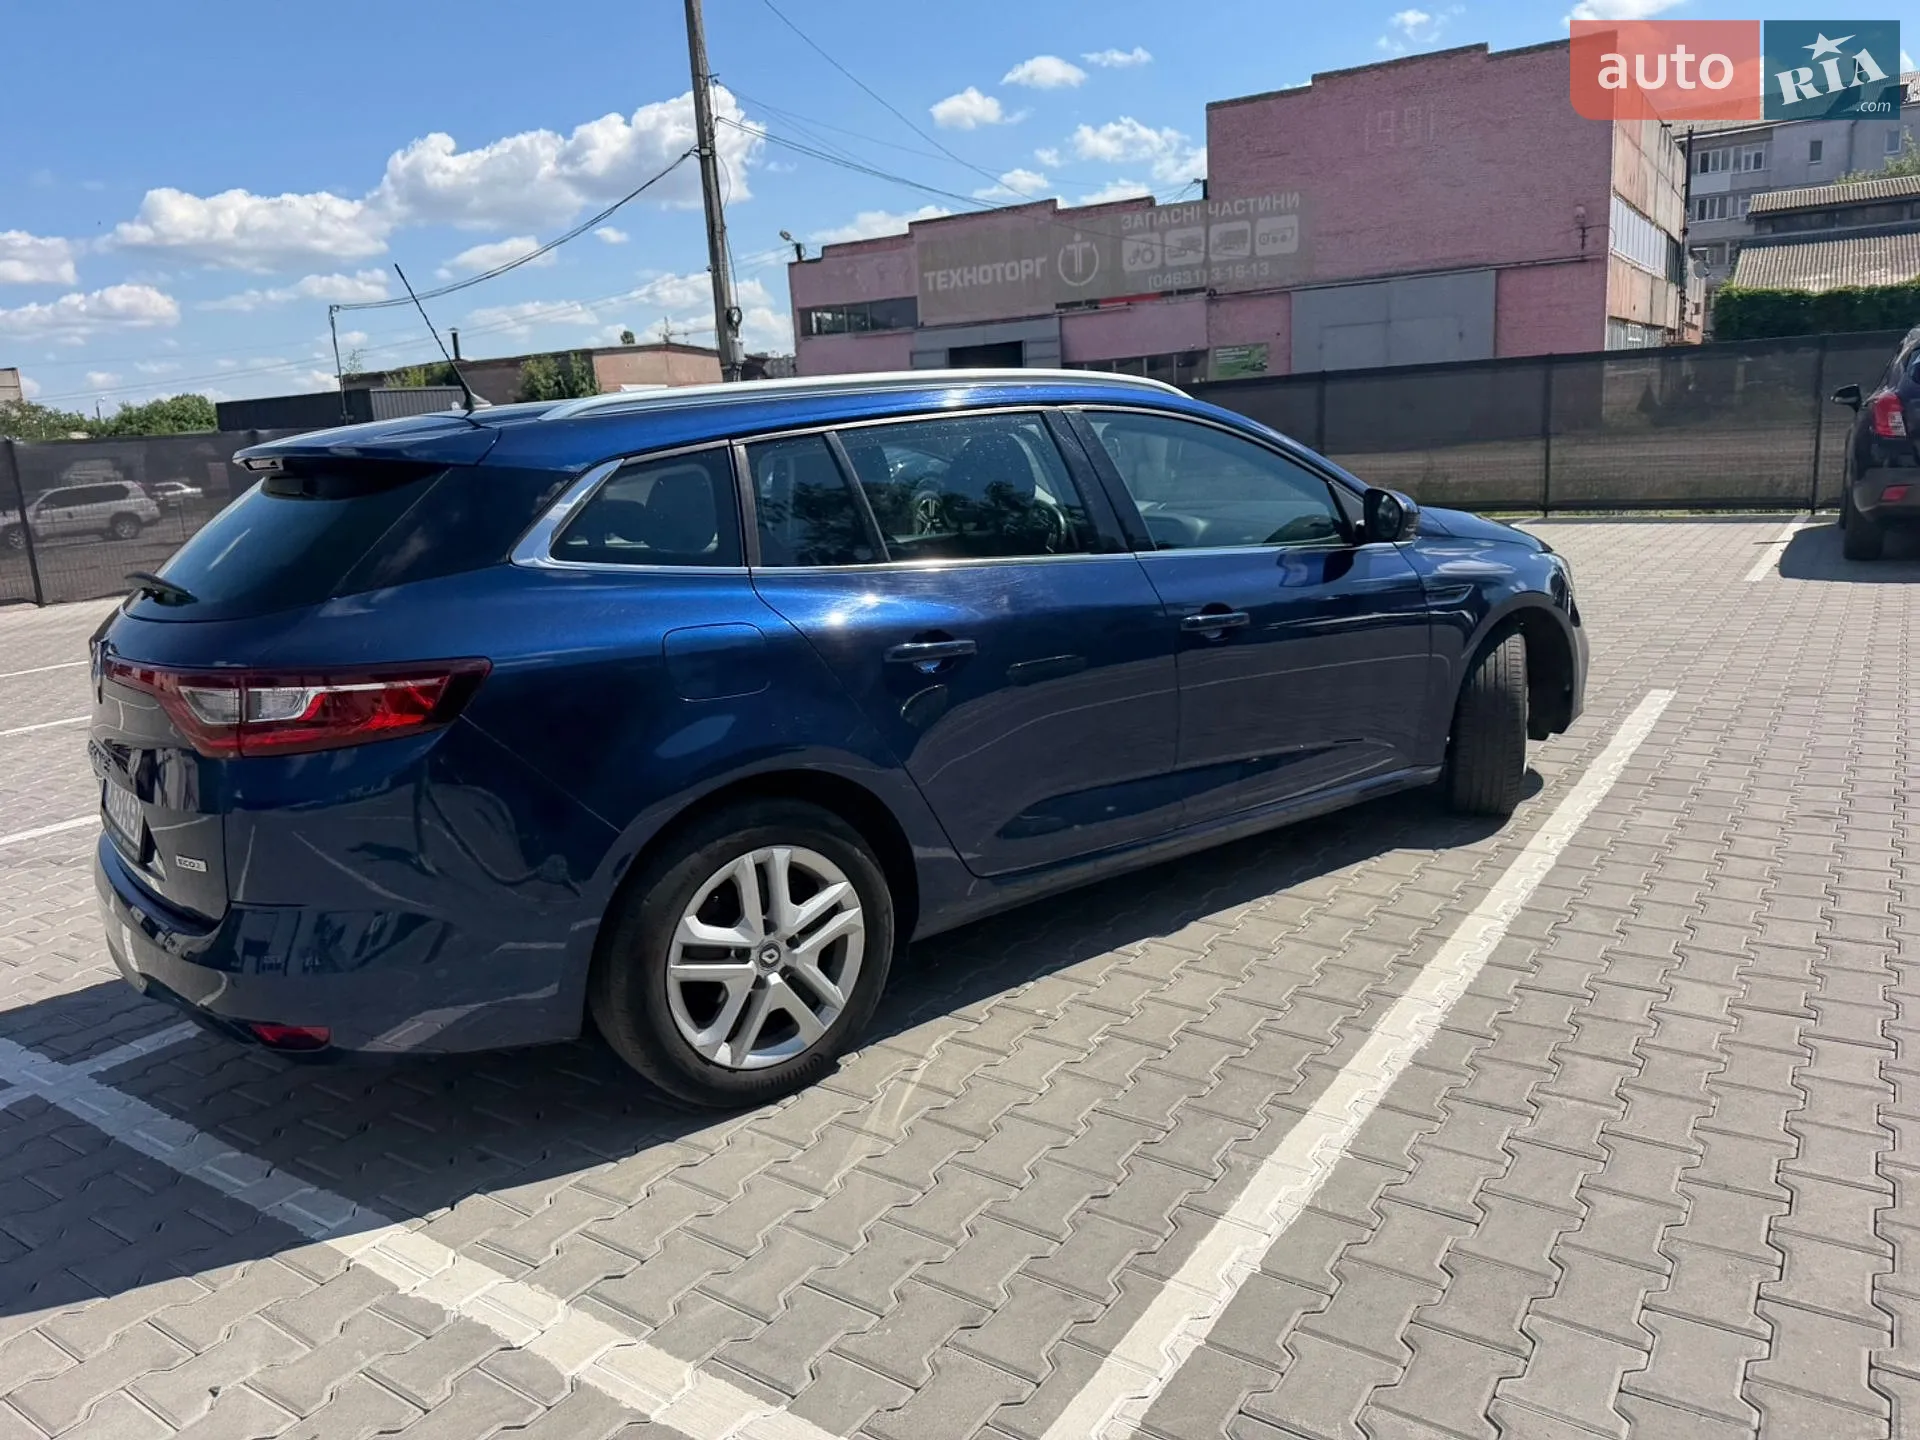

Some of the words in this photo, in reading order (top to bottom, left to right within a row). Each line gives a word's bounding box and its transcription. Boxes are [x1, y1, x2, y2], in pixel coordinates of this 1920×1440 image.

[1121, 206, 1200, 230] ЗАПАСНІ
[1207, 192, 1300, 217] ЧАСТИНИ
[923, 256, 1047, 292] ТЕХНОТОРГ
